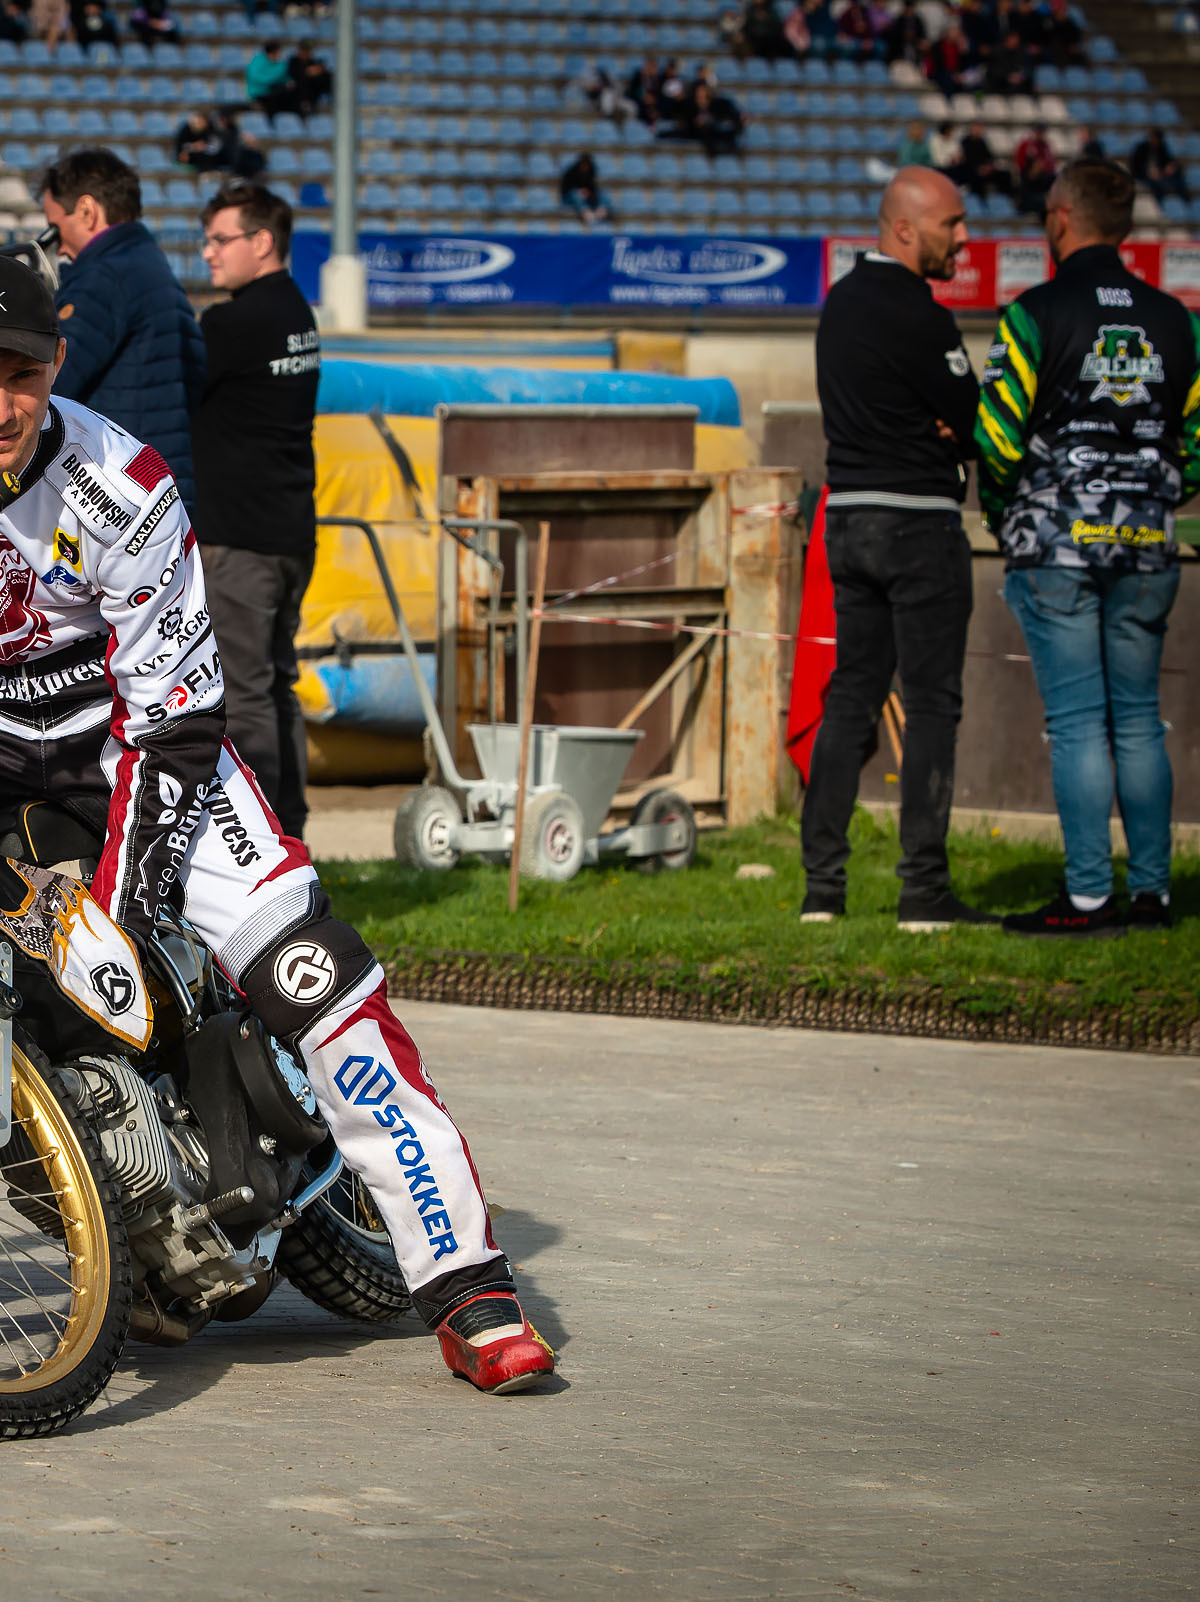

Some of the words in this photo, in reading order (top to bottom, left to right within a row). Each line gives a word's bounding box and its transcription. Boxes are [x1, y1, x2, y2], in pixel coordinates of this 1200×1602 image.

[61, 453, 134, 531] BARANOWSKY
[66, 480, 111, 529] FAMILY
[126, 491, 171, 554] MALINIAK
[372, 1104, 459, 1261] STOKKER
